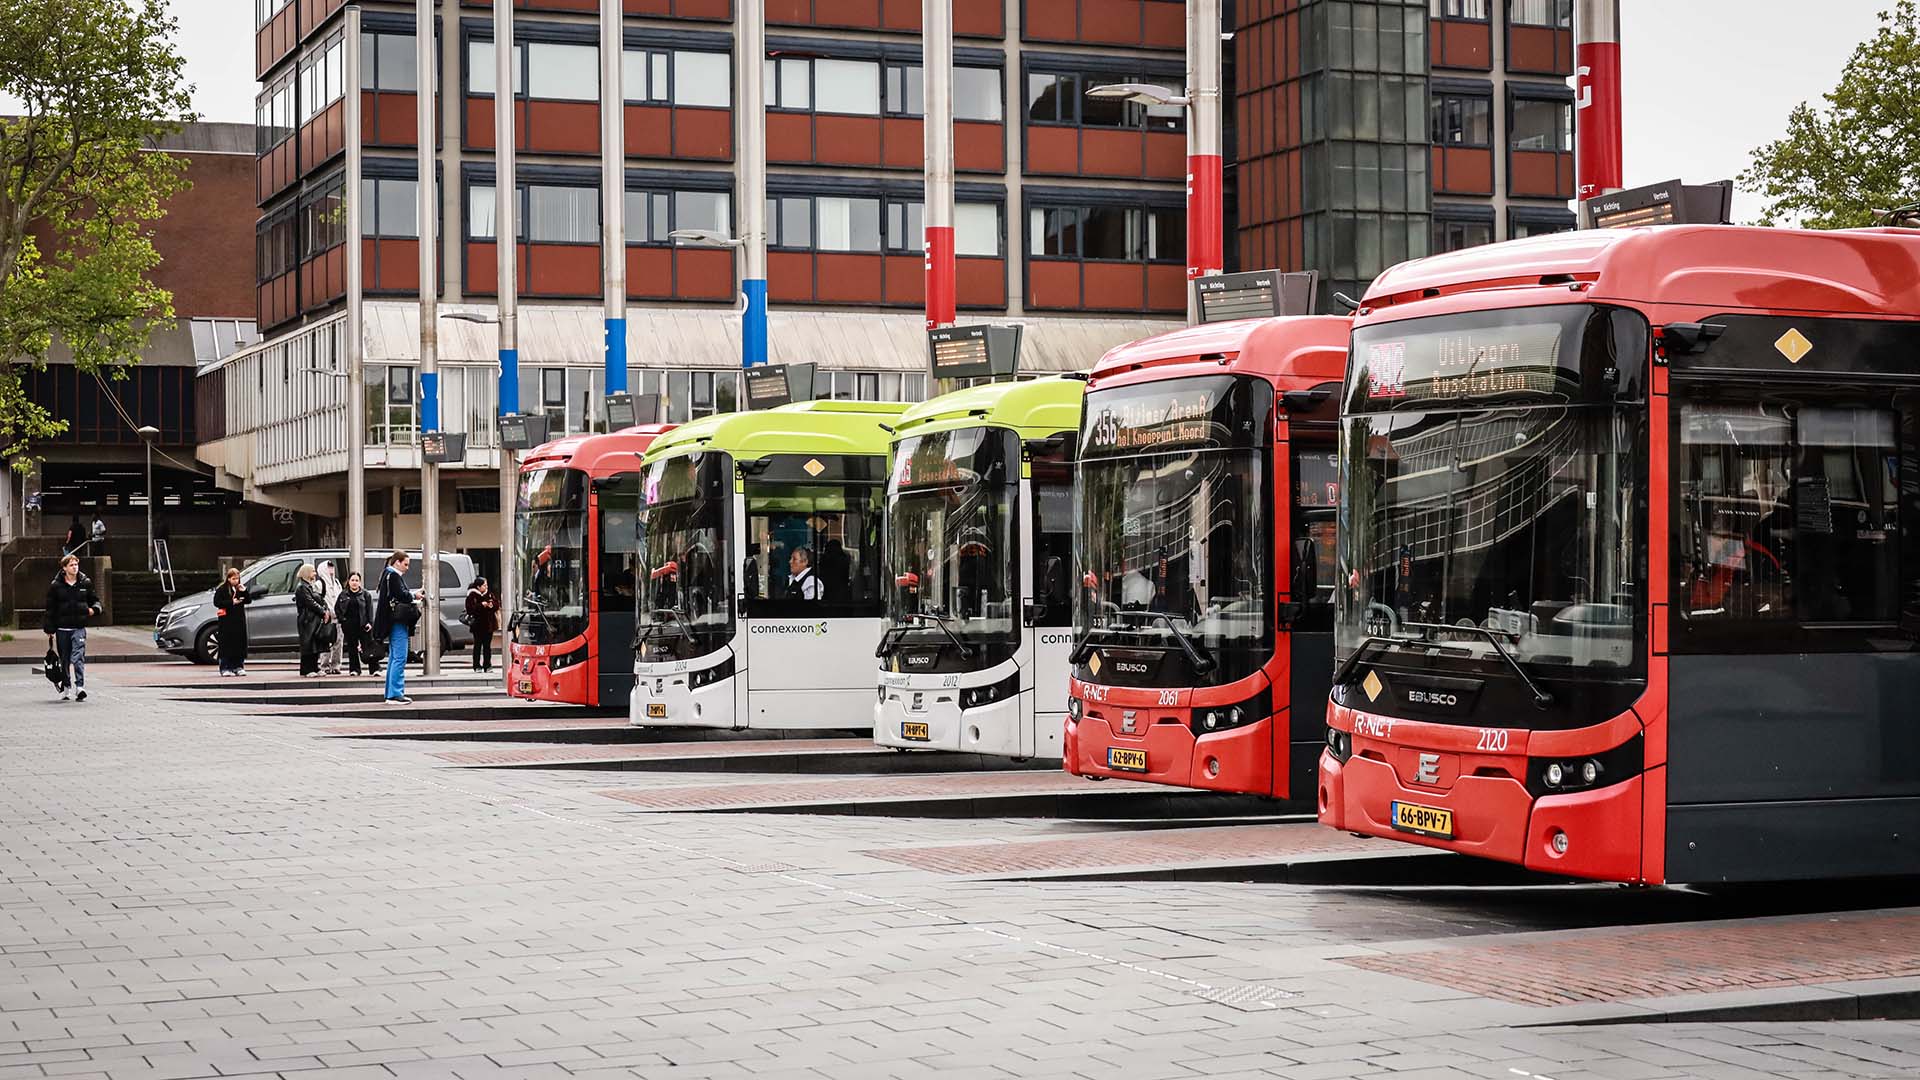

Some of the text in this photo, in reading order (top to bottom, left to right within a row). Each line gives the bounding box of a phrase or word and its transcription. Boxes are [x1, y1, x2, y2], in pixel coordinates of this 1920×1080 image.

[1095, 409, 1118, 447] 356
[456, 526, 463, 535] 8
[750, 624, 814, 635] connexxion
[1116, 662, 1148, 673] EBUSCO
[943, 675, 959, 688] 2012
[1158, 690, 1179, 706] 2061
[1408, 690, 1457, 706] EBUSCO
[1476, 729, 1508, 751] 2120
[1113, 751, 1145, 766] 62-BPV-6
[1400, 806, 1448, 831] 66-BPV-7
